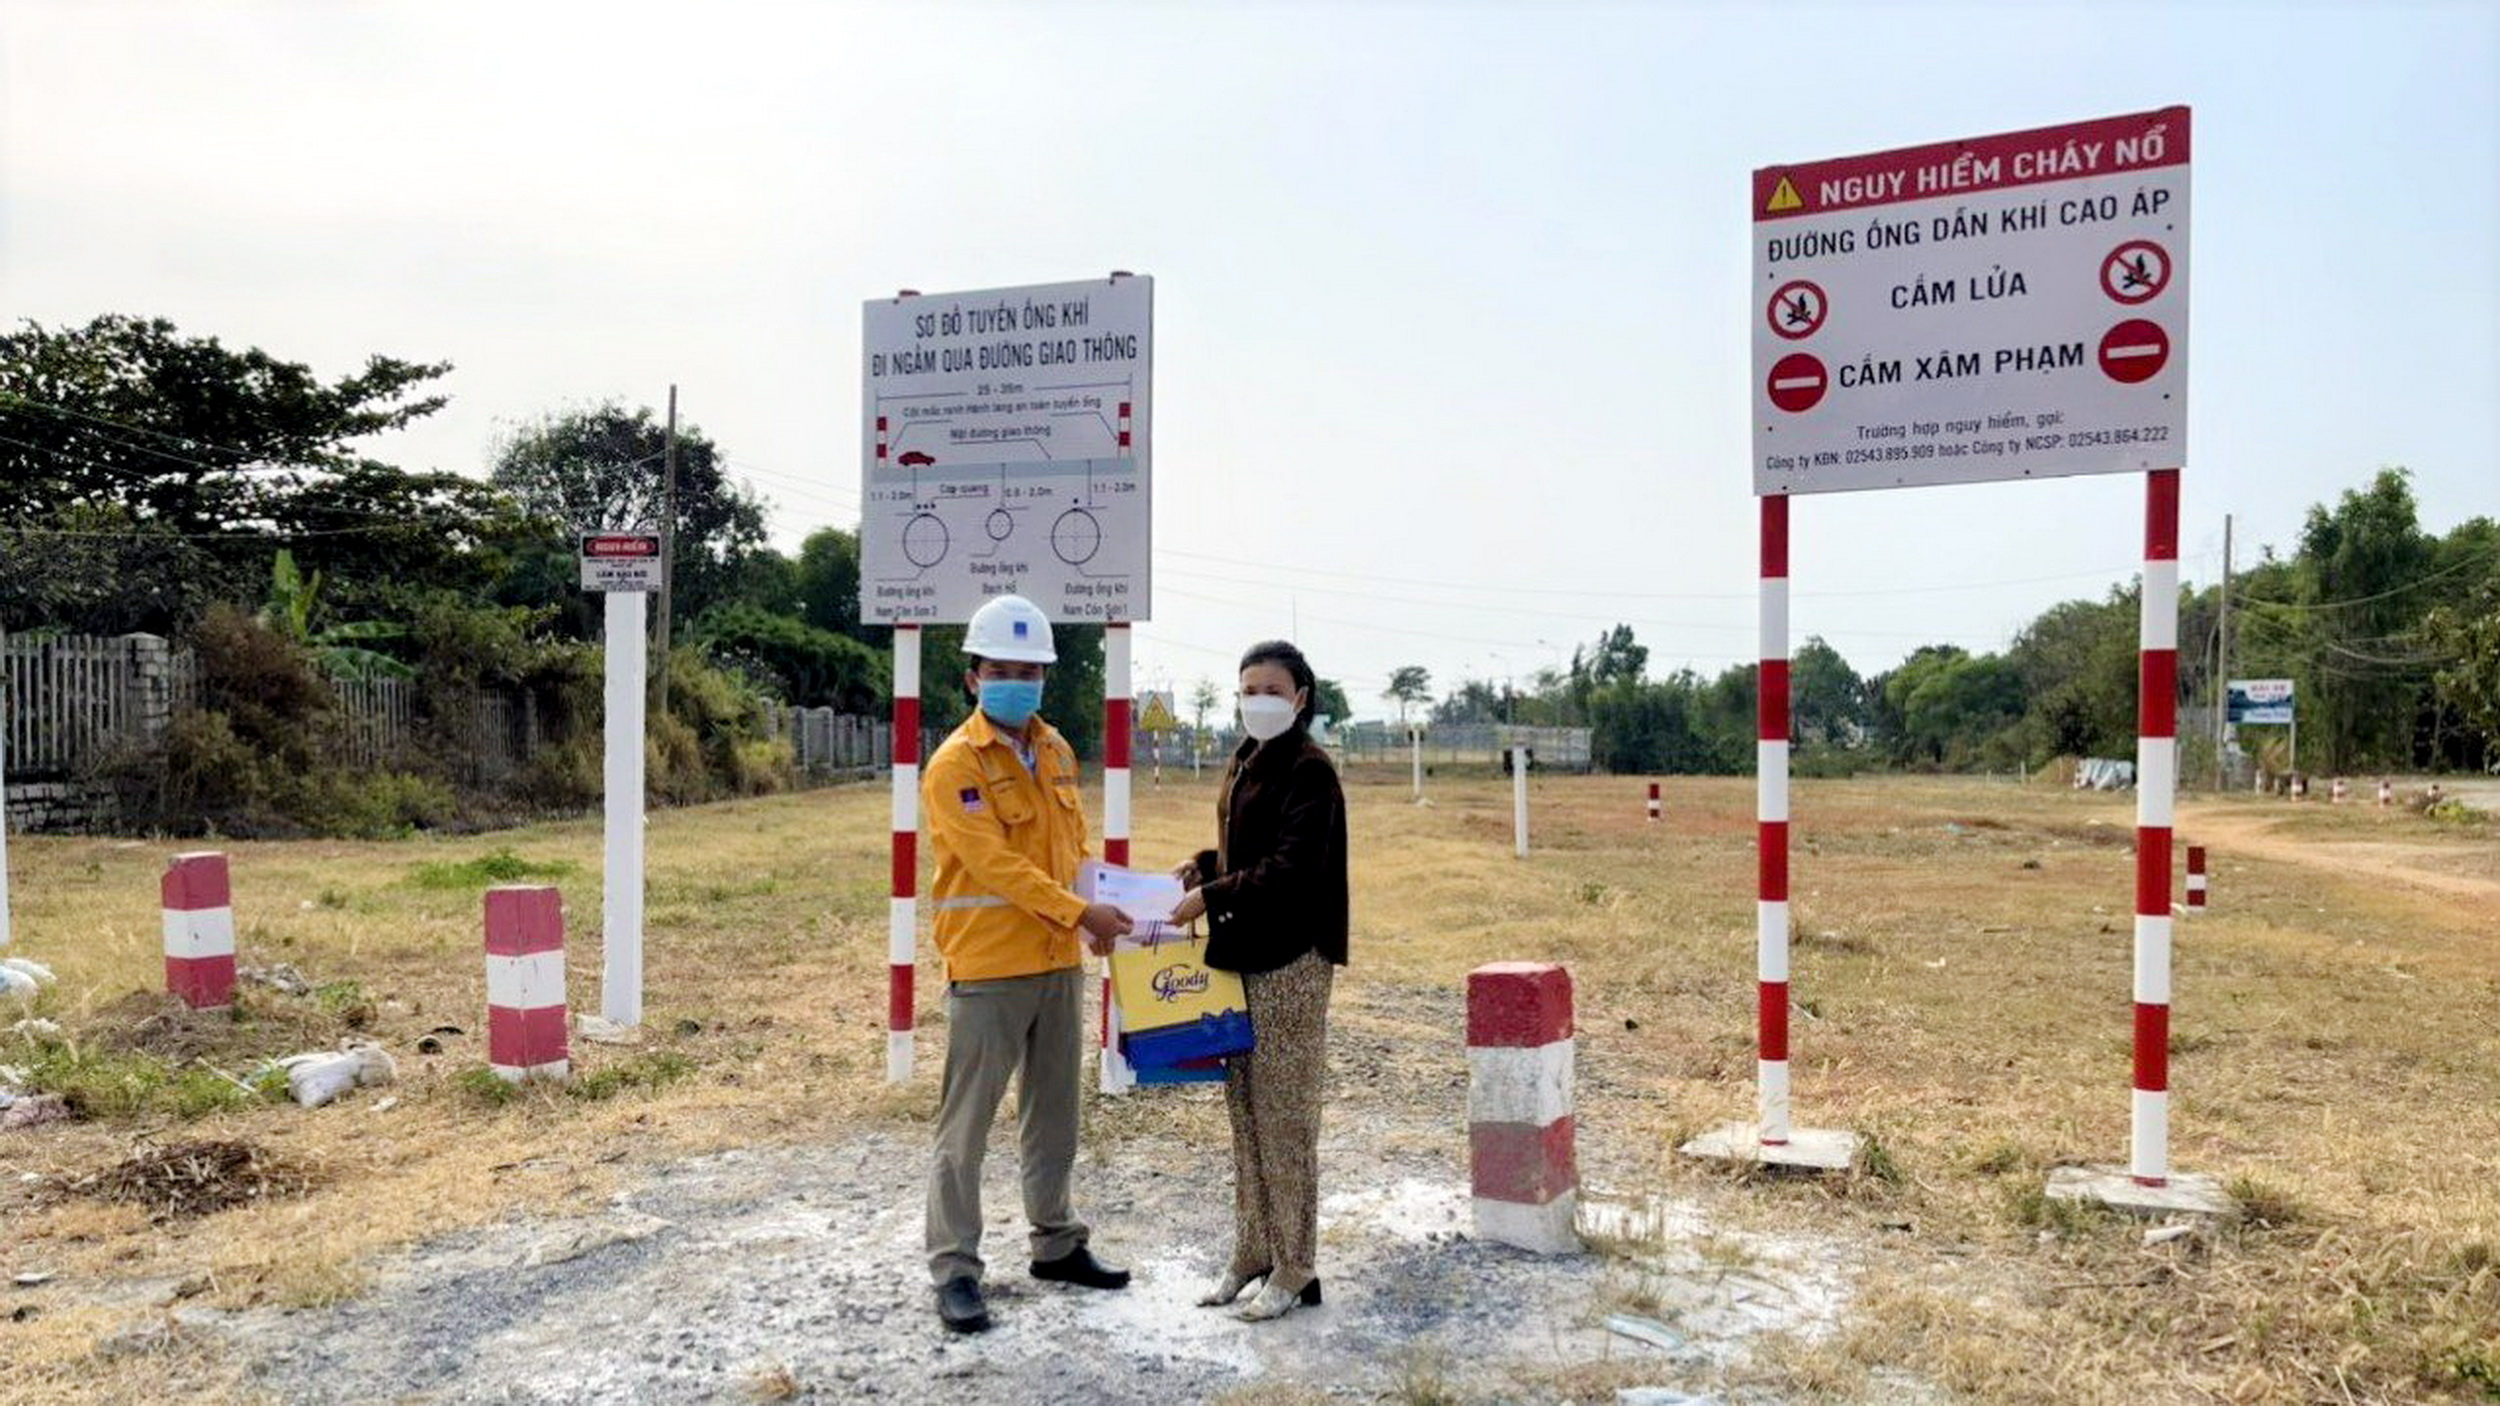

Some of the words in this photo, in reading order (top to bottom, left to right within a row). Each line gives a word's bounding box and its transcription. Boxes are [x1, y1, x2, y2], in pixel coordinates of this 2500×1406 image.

[1820, 171, 1906, 206] NGUY
[1918, 151, 2000, 193] HIỂM
[2013, 139, 2101, 179] CHÁY
[2115, 124, 2168, 163] NỔ
[1768, 226, 1855, 263] ĐƯỜNG
[1867, 217, 1921, 251] ỐNG
[1933, 207, 1988, 242] DẪN
[2001, 200, 2046, 233] KHÍ
[2060, 196, 2118, 227] CAO
[2131, 188, 2170, 217] ÁP
[1891, 272, 1955, 309] CẤM
[1970, 264, 2027, 301] LỬA
[916, 314, 935, 338] SƠ
[941, 305, 962, 335] ĐỒ
[968, 301, 1017, 334] TUYẾN
[1023, 300, 1055, 328] ỐNG
[1062, 296, 1090, 326] KHÍ
[872, 354, 887, 376] ĐI
[892, 346, 936, 375] NGẦM
[942, 348, 974, 372] QUA
[979, 341, 1032, 370] ĐƯỜNG
[1039, 340, 1077, 364] GIAO
[1083, 332, 1137, 361] THÔNG
[1839, 354, 1901, 388] CẤM
[1916, 350, 1980, 380] XÂM
[1995, 342, 2084, 375] PHẠM
[1856, 424, 1906, 439] Trường
[1912, 421, 1939, 436] hợp
[1945, 417, 1981, 433] nguy
[1988, 411, 2029, 428] hiểm,
[2036, 411, 2064, 429] gọi:
[1766, 455, 1794, 471] Công
[1799, 455, 1810, 470] ty
[1973, 440, 2003, 455] Công
[2009, 439, 2021, 455] ty
